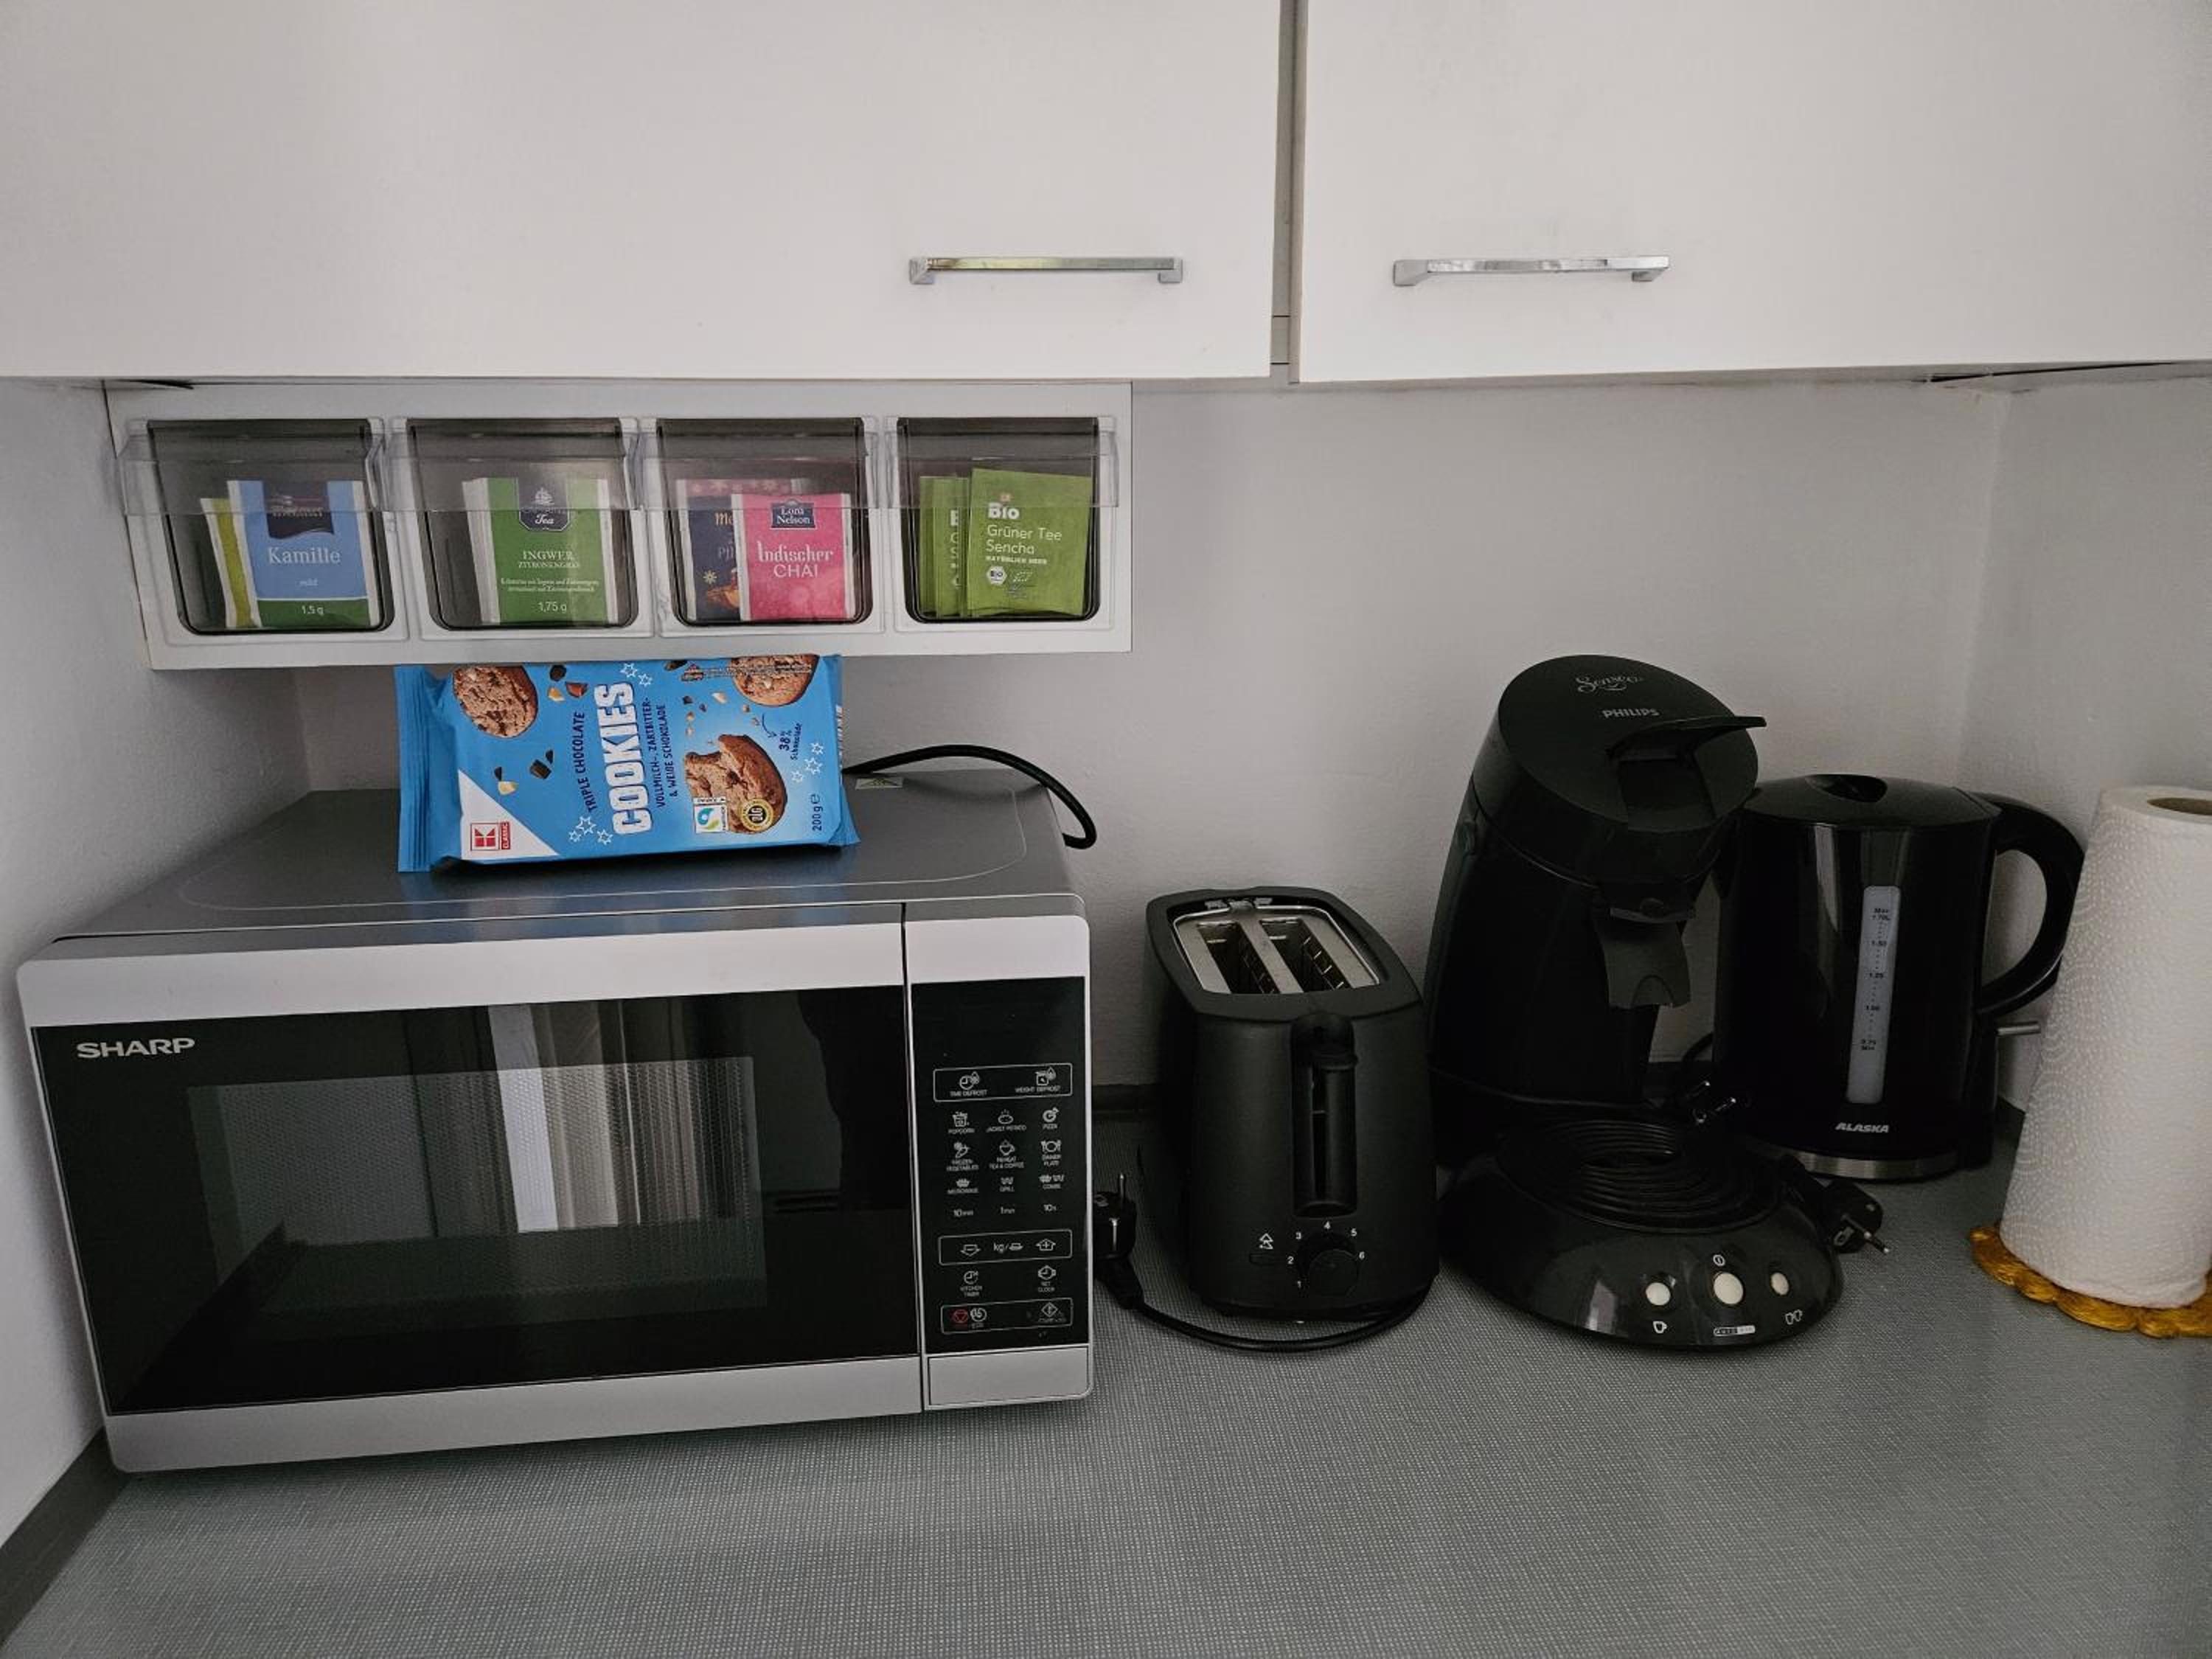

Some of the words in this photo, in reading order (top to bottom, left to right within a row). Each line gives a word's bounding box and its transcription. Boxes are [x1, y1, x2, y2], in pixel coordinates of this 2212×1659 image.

[988, 502, 1020, 520] Bio
[535, 514, 554, 524] Tea
[776, 515, 810, 525] Nelson
[987, 524, 1034, 539] Grüner
[1038, 527, 1062, 540] Tee
[757, 540, 834, 563] Indischer
[986, 539, 1035, 554] Sencha
[268, 546, 341, 564] Kamille
[522, 550, 575, 560] INGWER
[773, 563, 818, 578] CHAI
[1601, 708, 1660, 719] PHILIPS
[571, 711, 587, 773] CHOCOLATE
[594, 681, 653, 835] COOKIES
[578, 776, 598, 812] TRIPLE
[76, 1037, 195, 1059] SHARP
[1834, 1121, 1890, 1134] ALASKA
[1324, 1220, 1331, 1229] 4
[1295, 1231, 1302, 1239] 3
[1350, 1228, 1357, 1237] 5
[1287, 1256, 1294, 1265] 2
[1358, 1251, 1365, 1259] 6
[1296, 1280, 1302, 1289] 1
